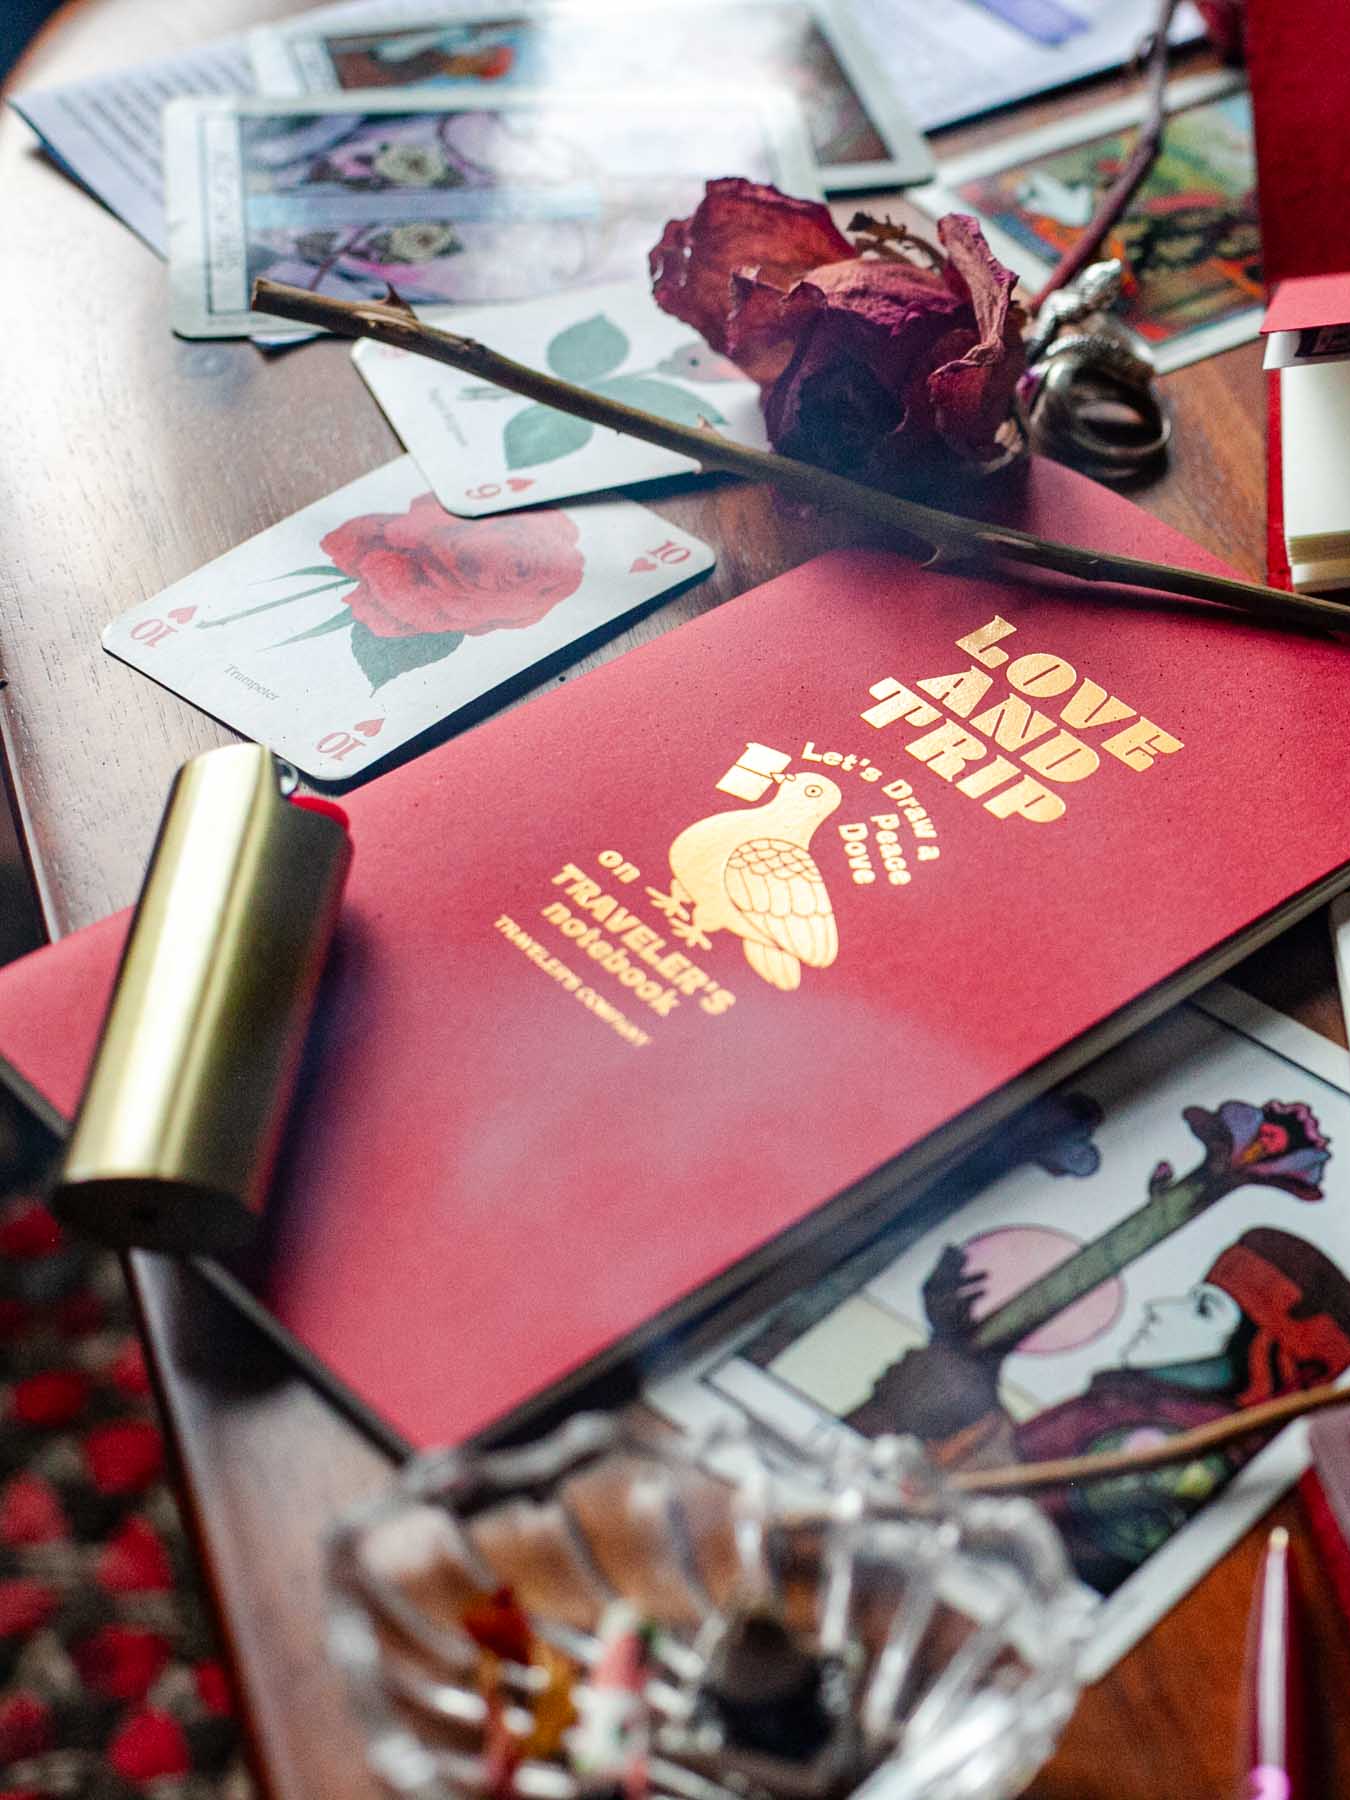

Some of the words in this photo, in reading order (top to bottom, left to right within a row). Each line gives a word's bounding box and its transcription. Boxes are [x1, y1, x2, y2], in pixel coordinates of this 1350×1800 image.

[649, 540, 692, 565] 10
[130, 617, 180, 647] 10
[916, 665, 1100, 782] AND
[955, 615, 1184, 772] LOVE
[317, 731, 367, 761] 10
[860, 677, 1066, 823] TRIP
[802, 741, 883, 782] Let's
[881, 779, 938, 838] Draw
[917, 845, 940, 861] a
[598, 850, 641, 884] on
[838, 822, 876, 884] Dove
[870, 814, 912, 885] Peace
[541, 902, 680, 1016] notebook
[551, 863, 737, 1015] TRAVELER'S
